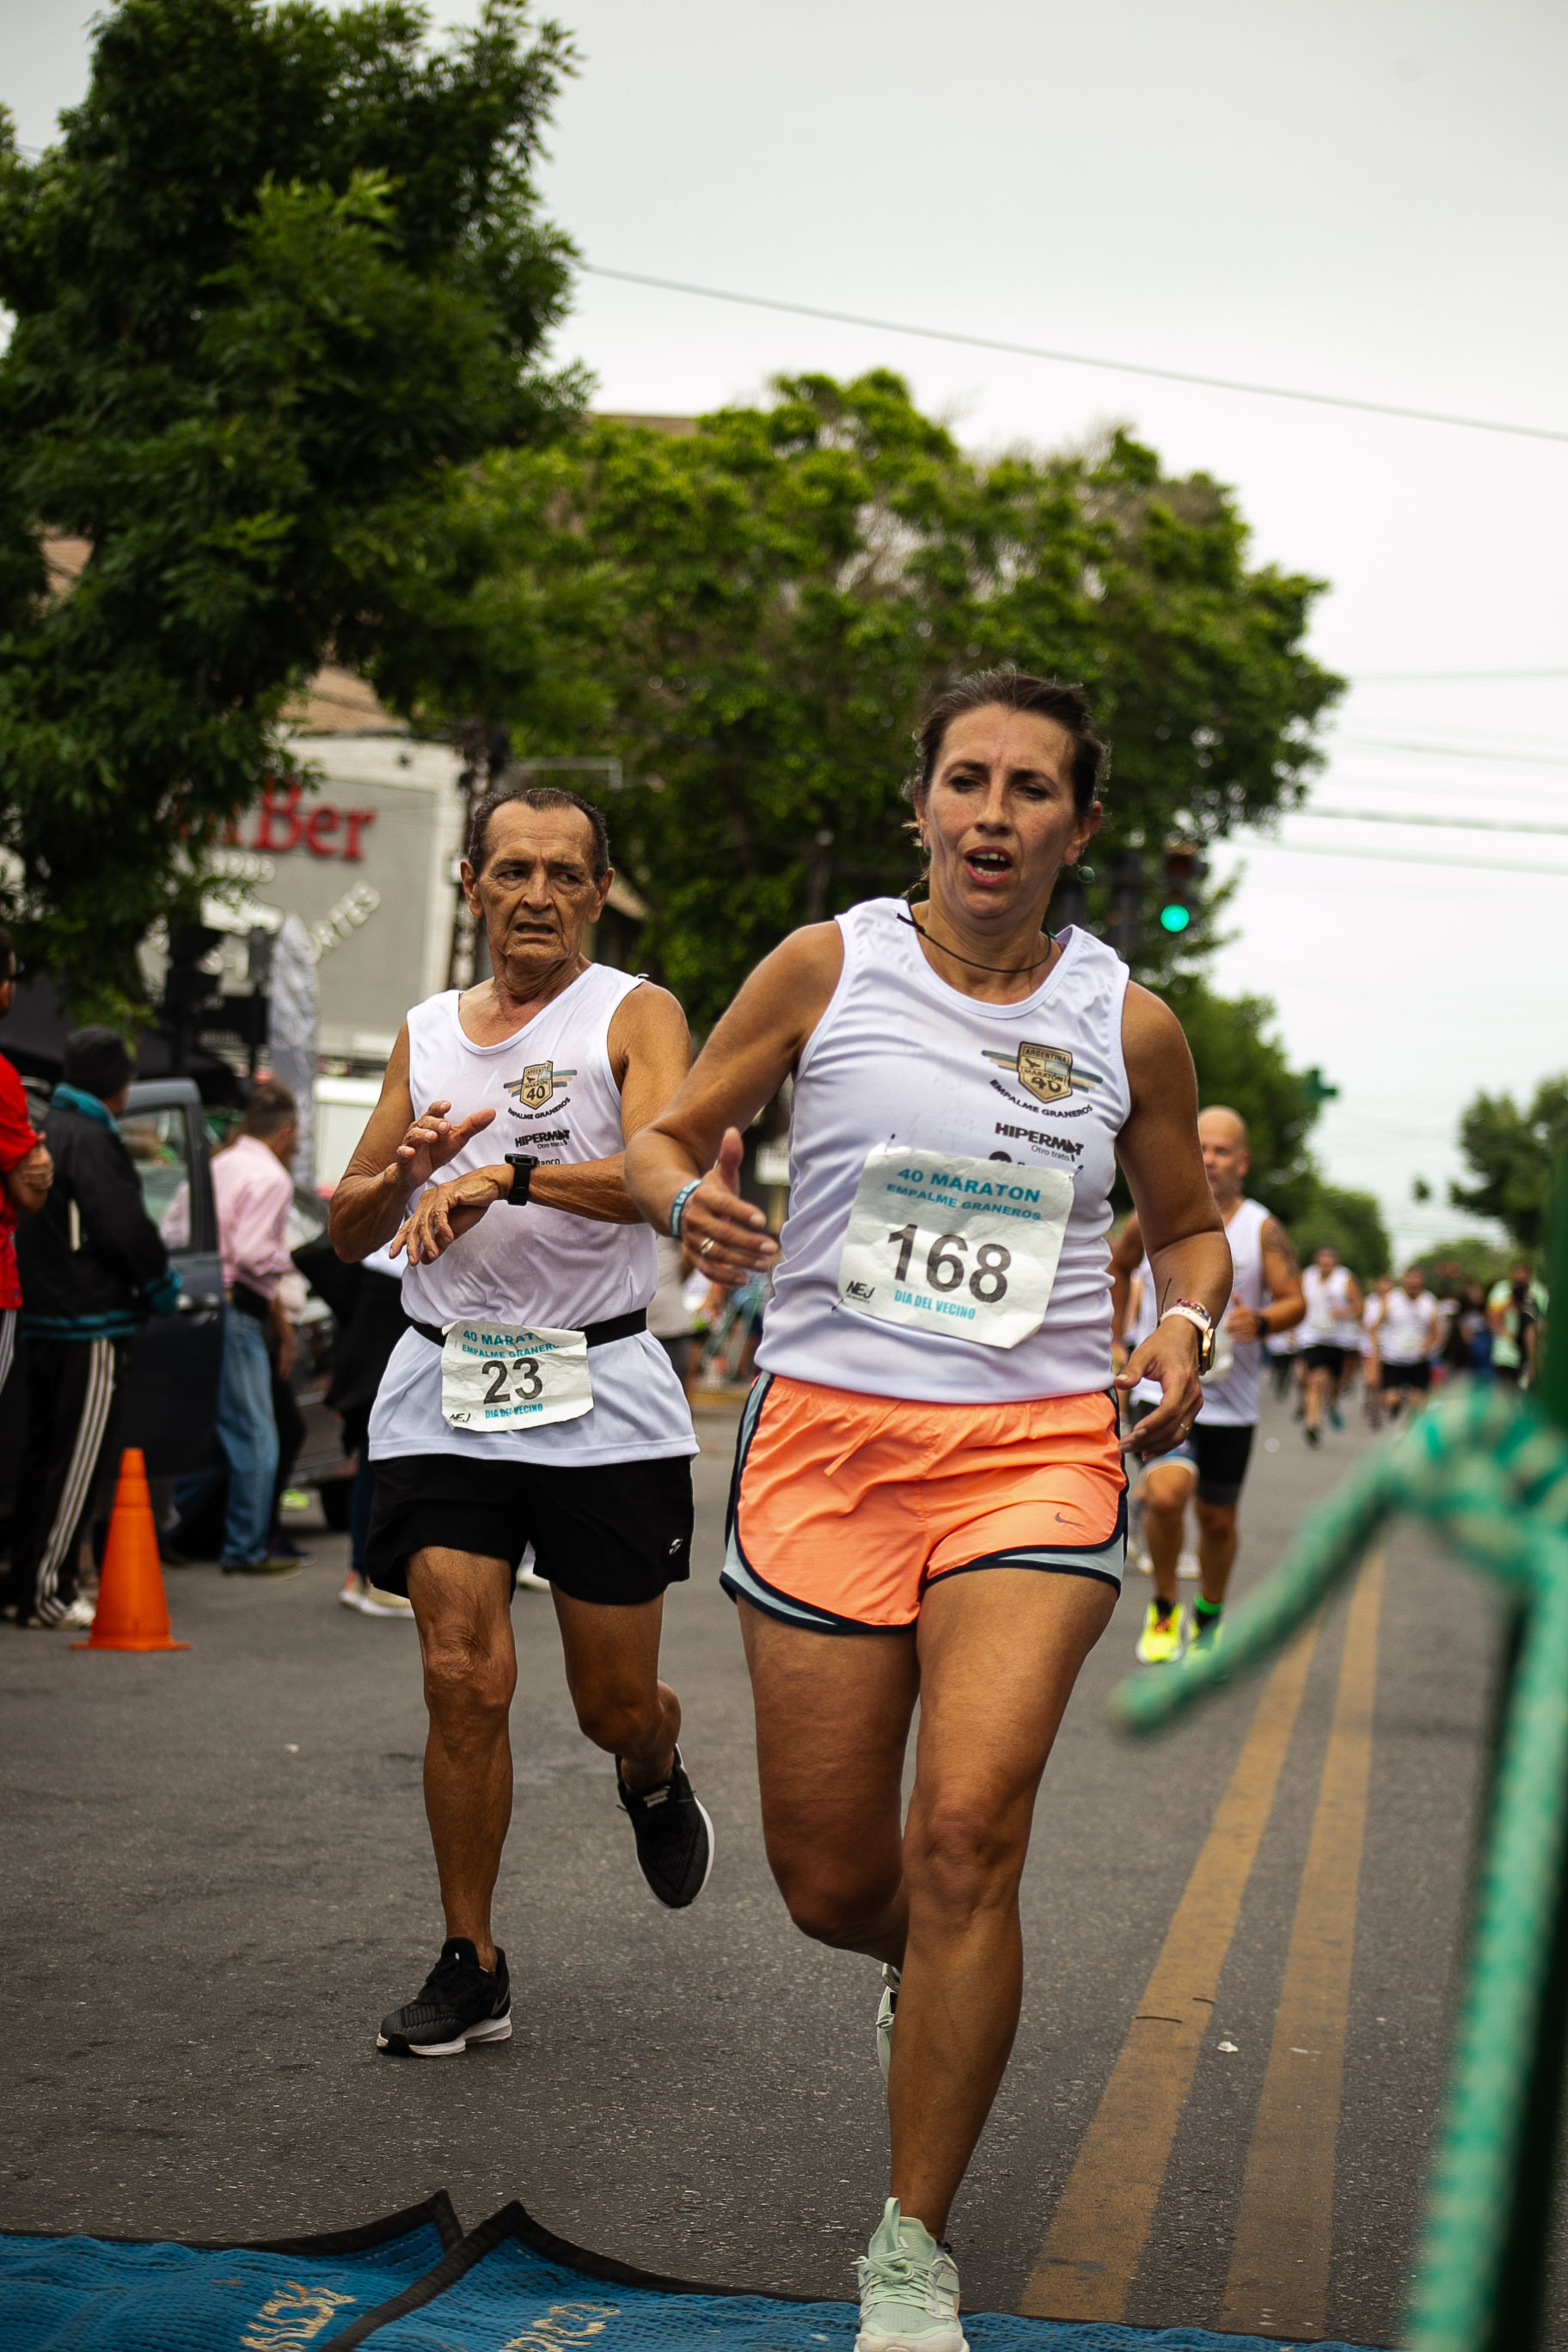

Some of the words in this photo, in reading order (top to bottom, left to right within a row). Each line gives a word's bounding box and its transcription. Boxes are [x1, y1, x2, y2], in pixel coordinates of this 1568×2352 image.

[1025, 1048, 1067, 1063] ARGENTINA
[526, 1085, 546, 1100] 40
[1032, 1076, 1062, 1093] 40
[535, 1096, 571, 1119] GRANEROS
[989, 1079, 1039, 1113] EMPALME
[1041, 1104, 1093, 1118] GRANEROS
[1031, 1144, 1050, 1155] Otro
[897, 1168, 924, 1183] 40
[930, 1173, 1041, 1204] MARATON
[886, 1184, 958, 1209] EMPALME
[960, 1201, 1042, 1221] GRANEROS
[888, 1223, 1012, 1303] 168
[894, 1289, 912, 1305] DIA
[914, 1295, 934, 1311] DEL
[935, 1299, 977, 1320] VECINO
[462, 1330, 479, 1343] 40
[462, 1344, 505, 1358] EMPALME
[508, 1344, 565, 1358] GRANER
[481, 1357, 543, 1405] 23
[485, 1409, 499, 1418] DIA
[513, 1403, 543, 1415] VECINO
